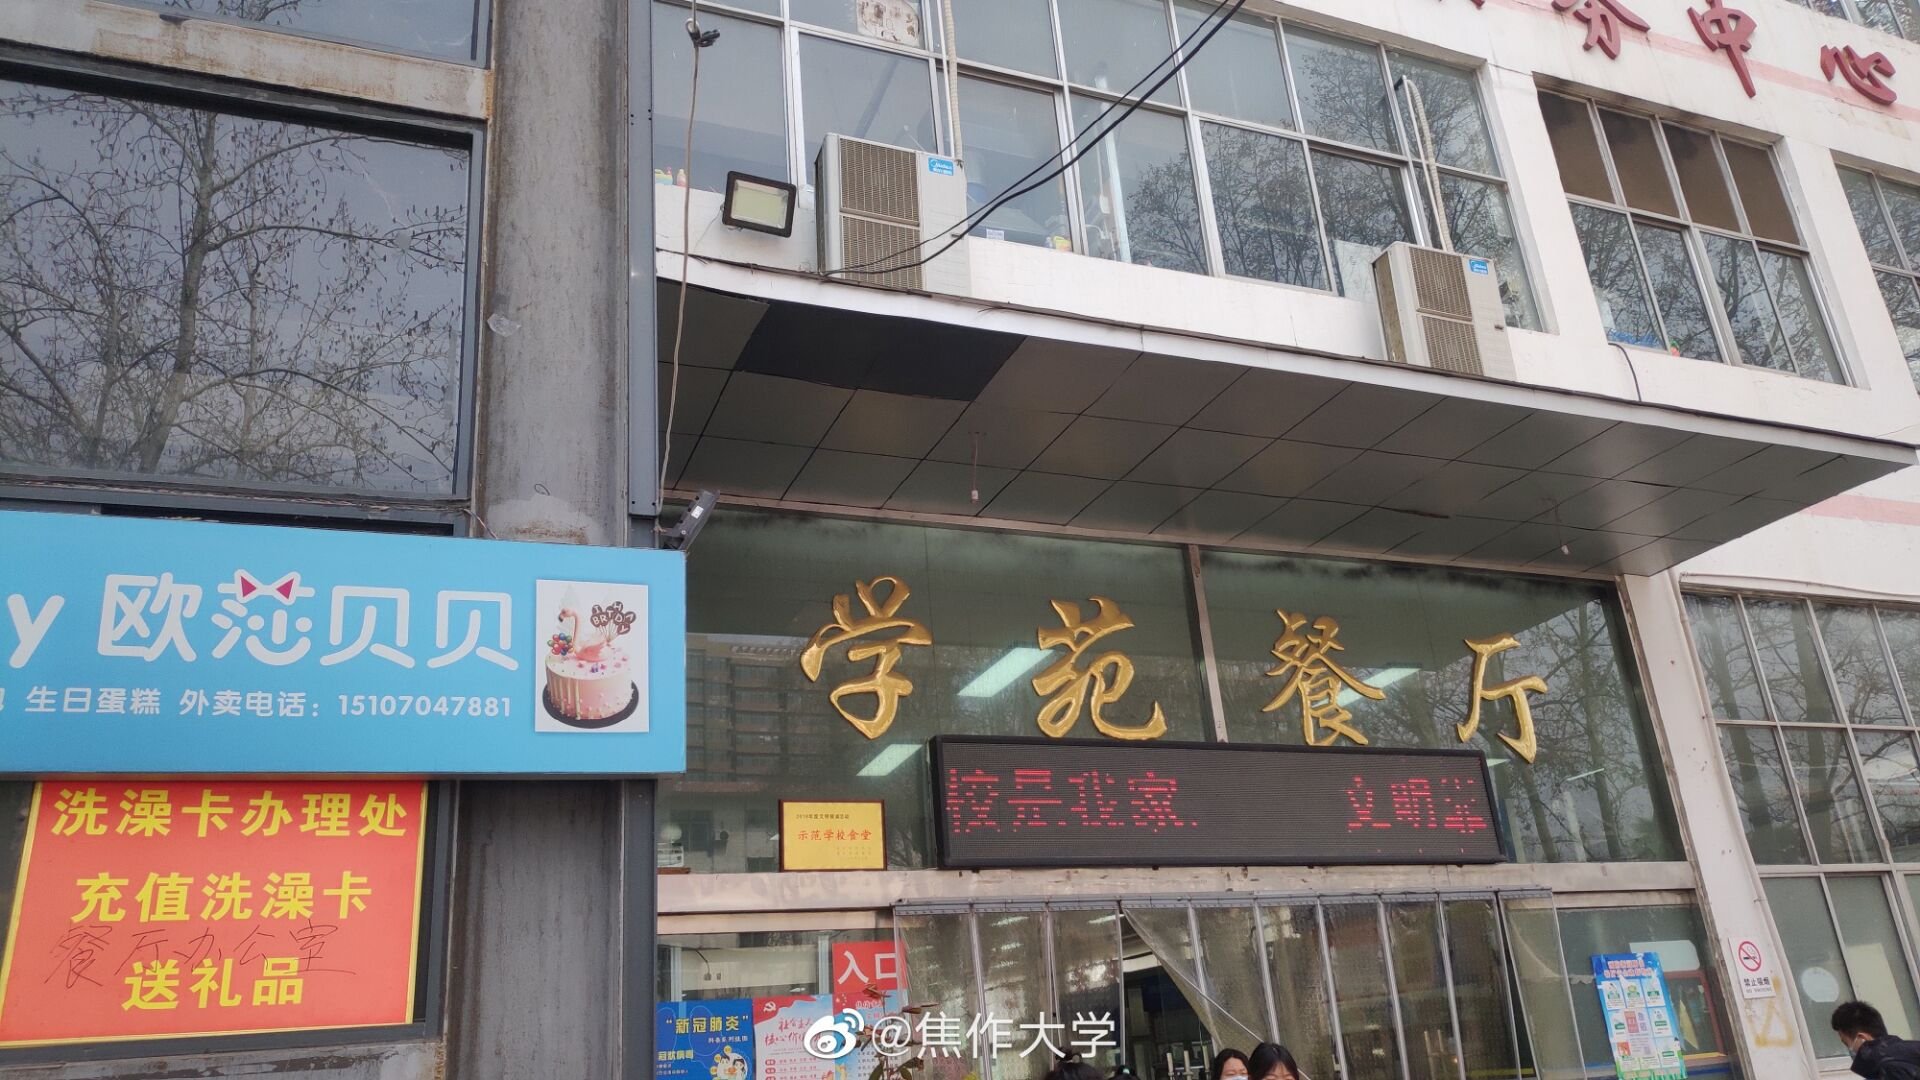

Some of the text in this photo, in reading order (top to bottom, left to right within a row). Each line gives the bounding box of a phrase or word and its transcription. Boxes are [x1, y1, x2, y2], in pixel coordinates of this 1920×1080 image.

[97, 568, 519, 670] 欧莎贝贝
[800, 575, 1548, 764] 学苑餐厅
[25, 686, 161, 715] 生日蛋糕
[51, 788, 407, 838] 洗澡卡办理处
[798, 829, 872, 841] 示范学校食堂
[71, 871, 373, 924] 充值洗澡卡
[121, 957, 304, 1011] 送礼品
[837, 950, 897, 984] 入口
